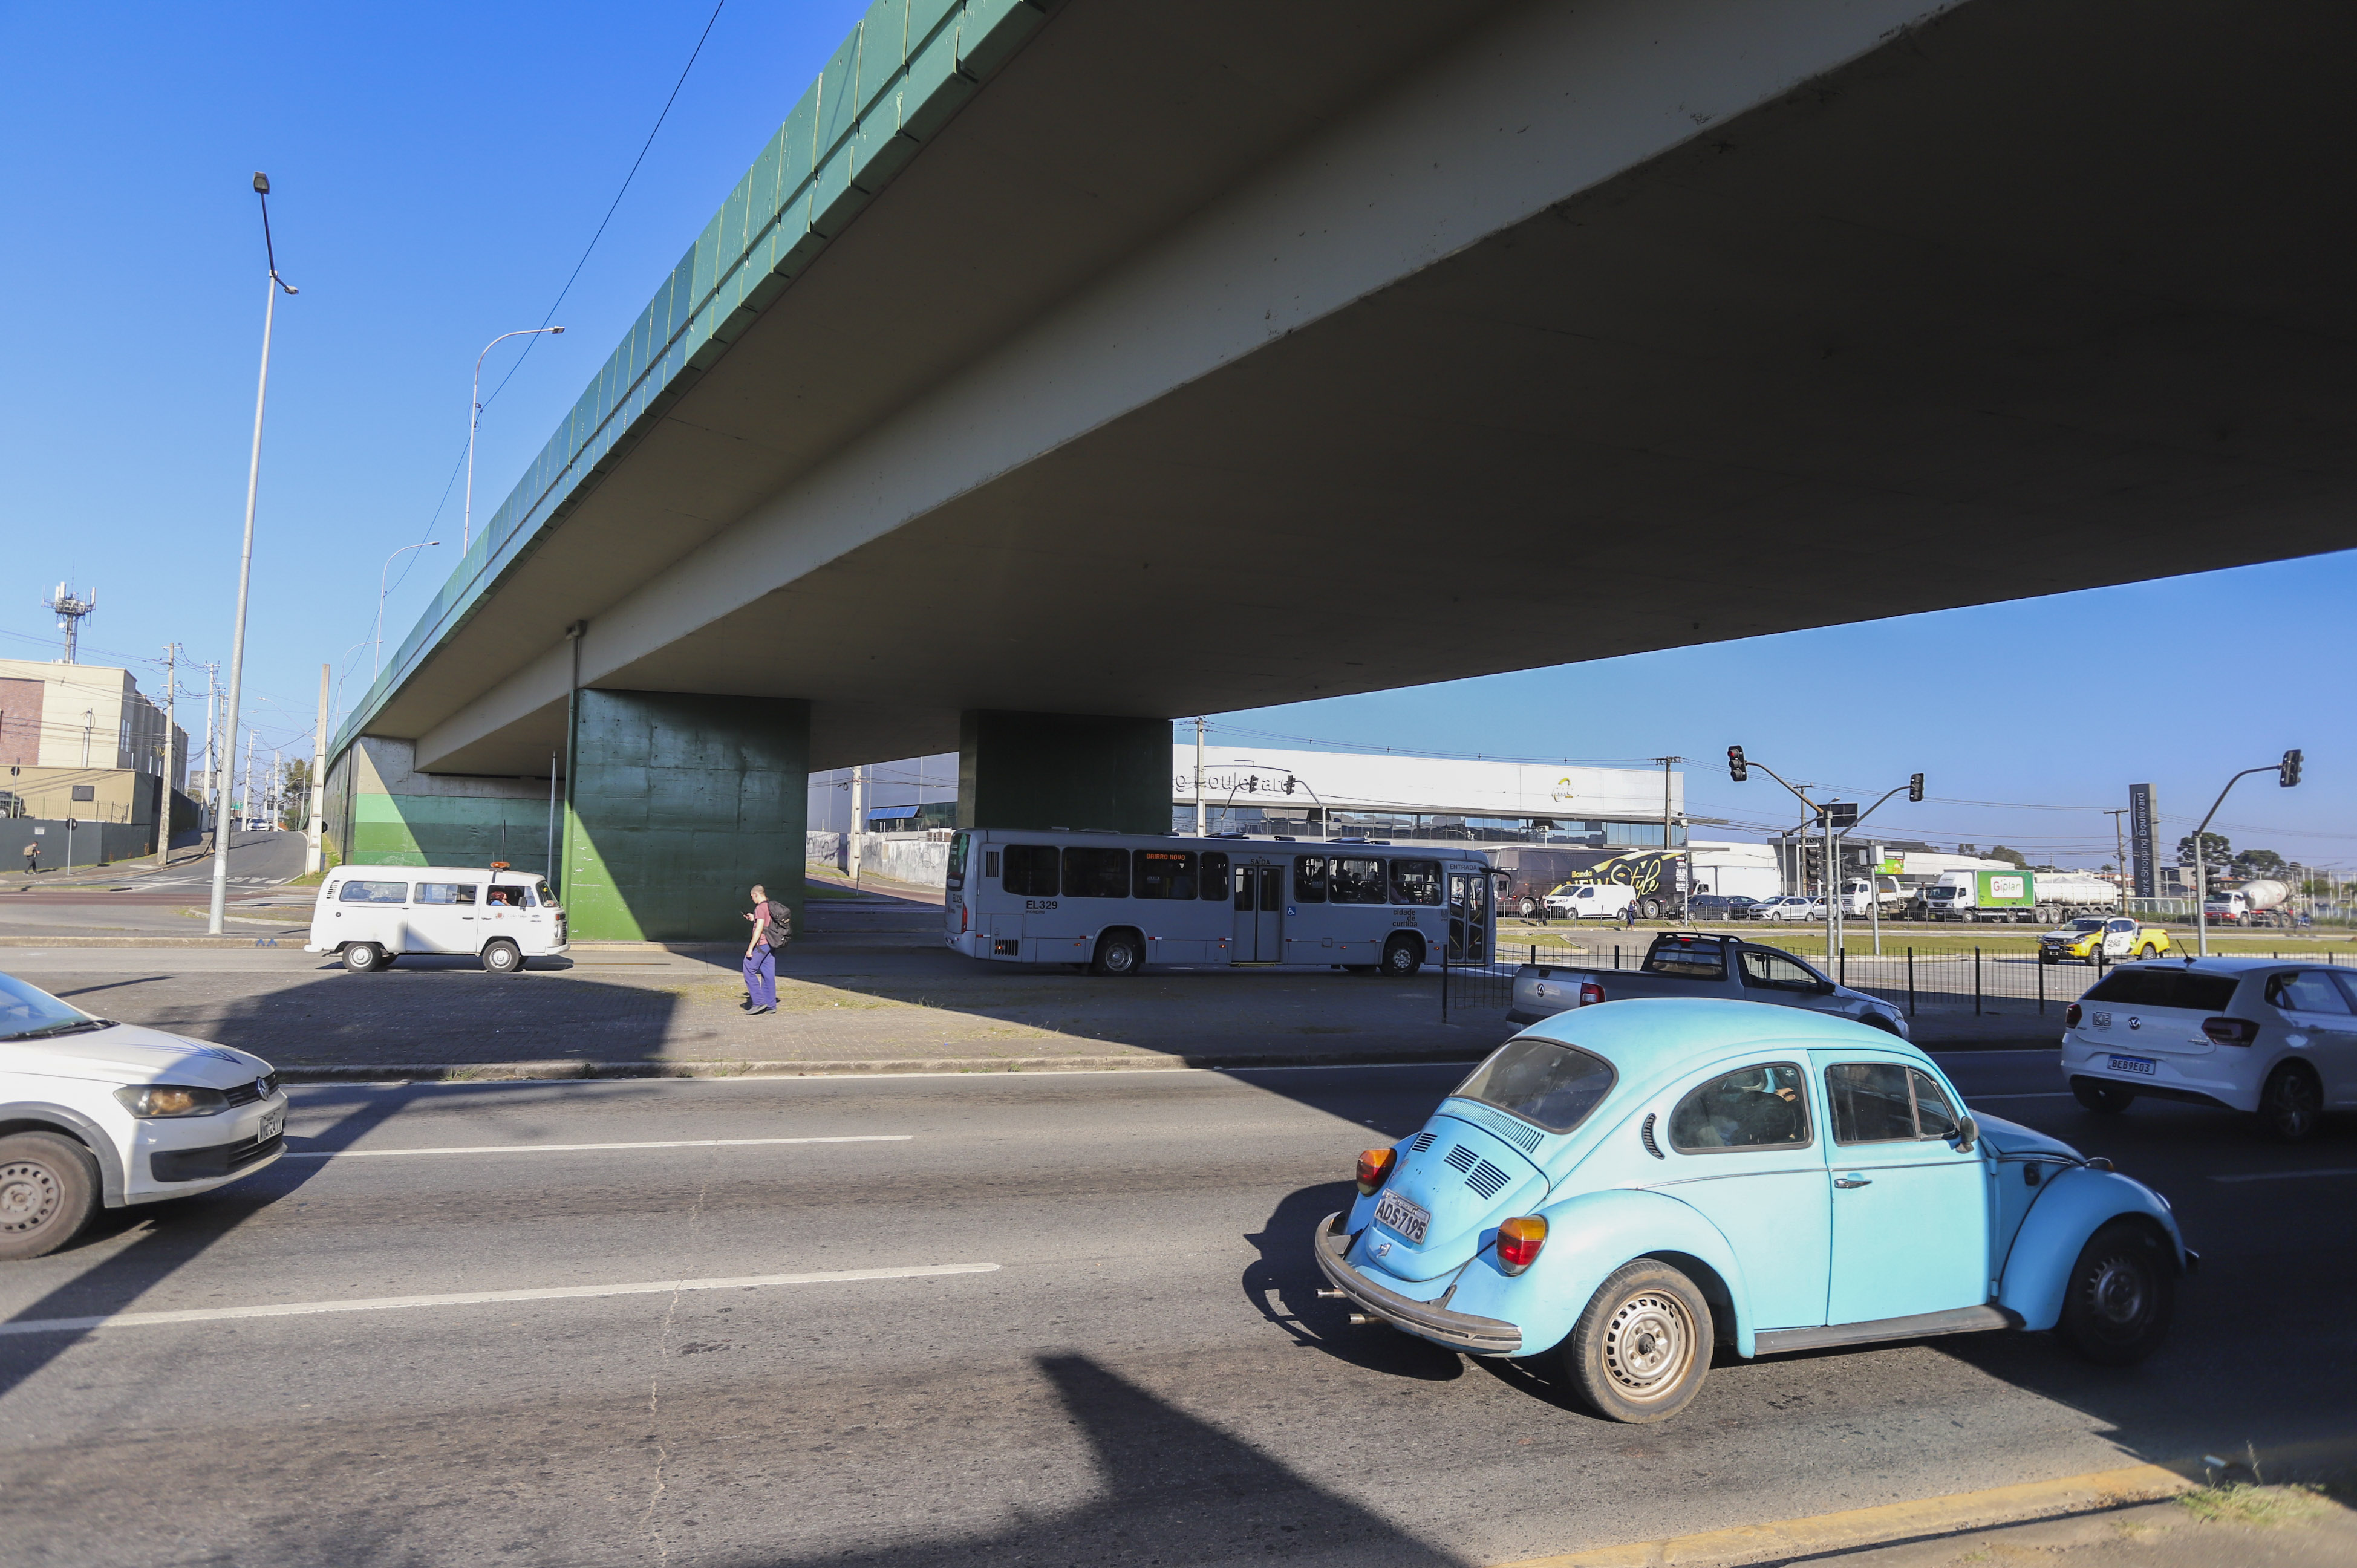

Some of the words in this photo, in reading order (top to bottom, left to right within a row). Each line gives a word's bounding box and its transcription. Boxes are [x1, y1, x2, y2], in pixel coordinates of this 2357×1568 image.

[2137, 792, 2147, 836] Boulevard
[1250, 856, 1270, 865] SAÍDA
[2140, 838, 2150, 877] Shopping
[1571, 869, 1593, 878] Banda
[1611, 859, 1661, 899] Style
[1993, 879, 2021, 893] Giplan
[1026, 900, 1058, 909] EL329
[2111, 1059, 2150, 1072] BEB9E03
